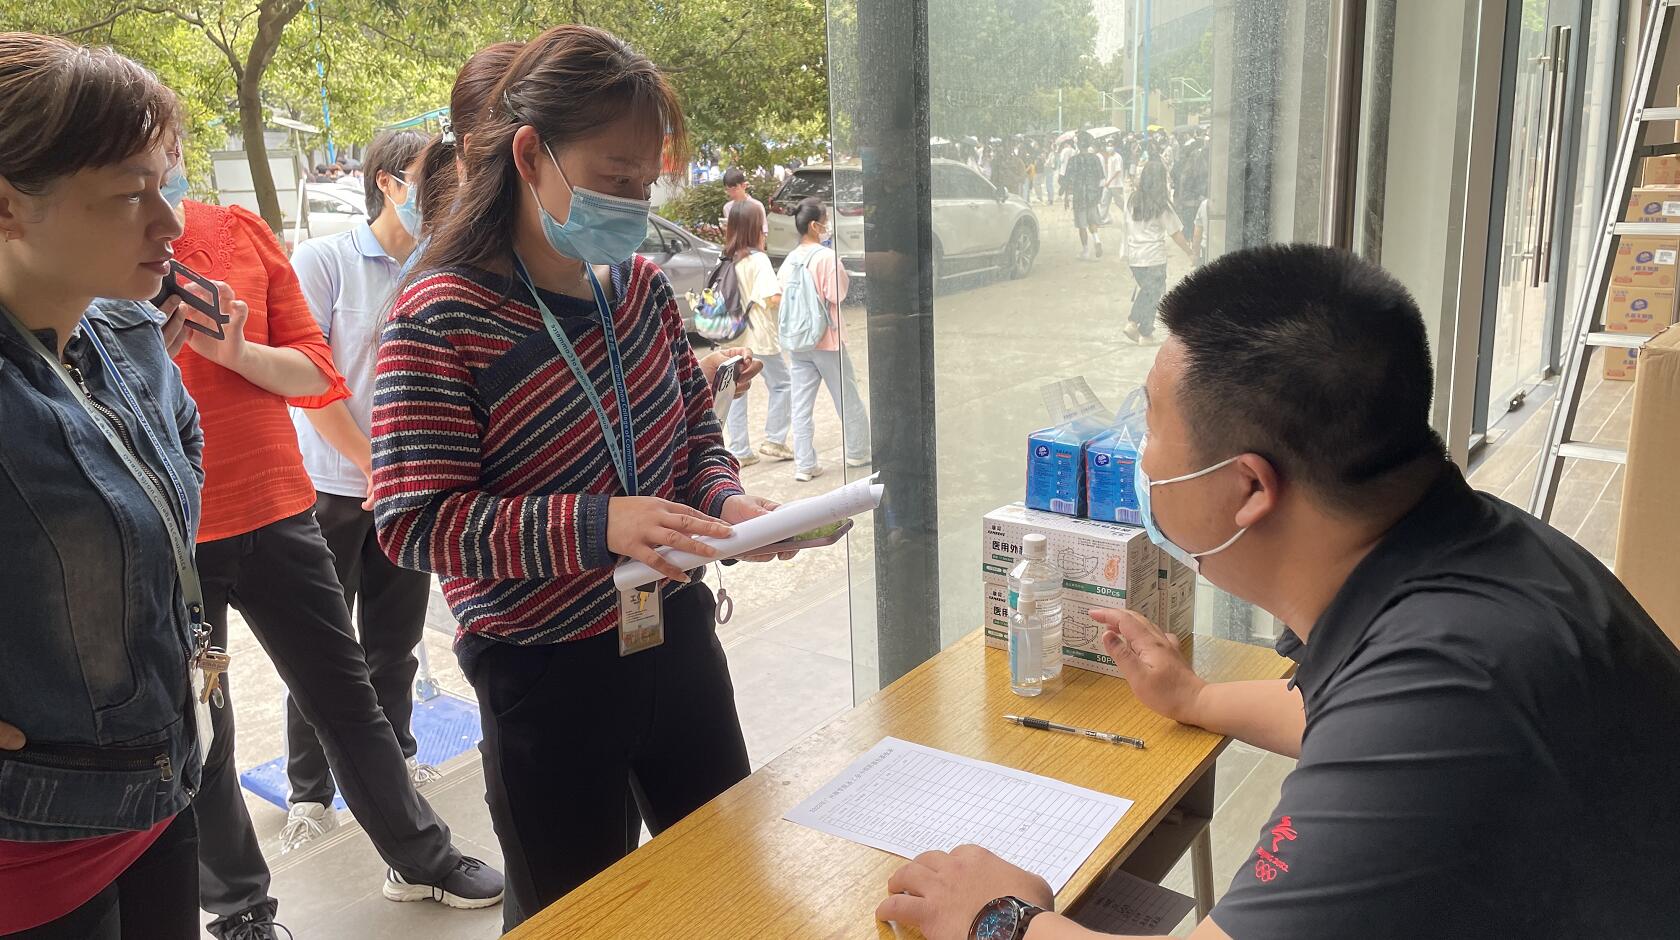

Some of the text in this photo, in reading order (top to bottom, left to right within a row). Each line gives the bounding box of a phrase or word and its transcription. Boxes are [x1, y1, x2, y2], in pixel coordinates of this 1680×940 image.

[614, 364, 626, 403] Guangzhou
[620, 403, 631, 430] College
[625, 438, 634, 477] Commerce
[1096, 586, 1121, 598] 50Pcs
